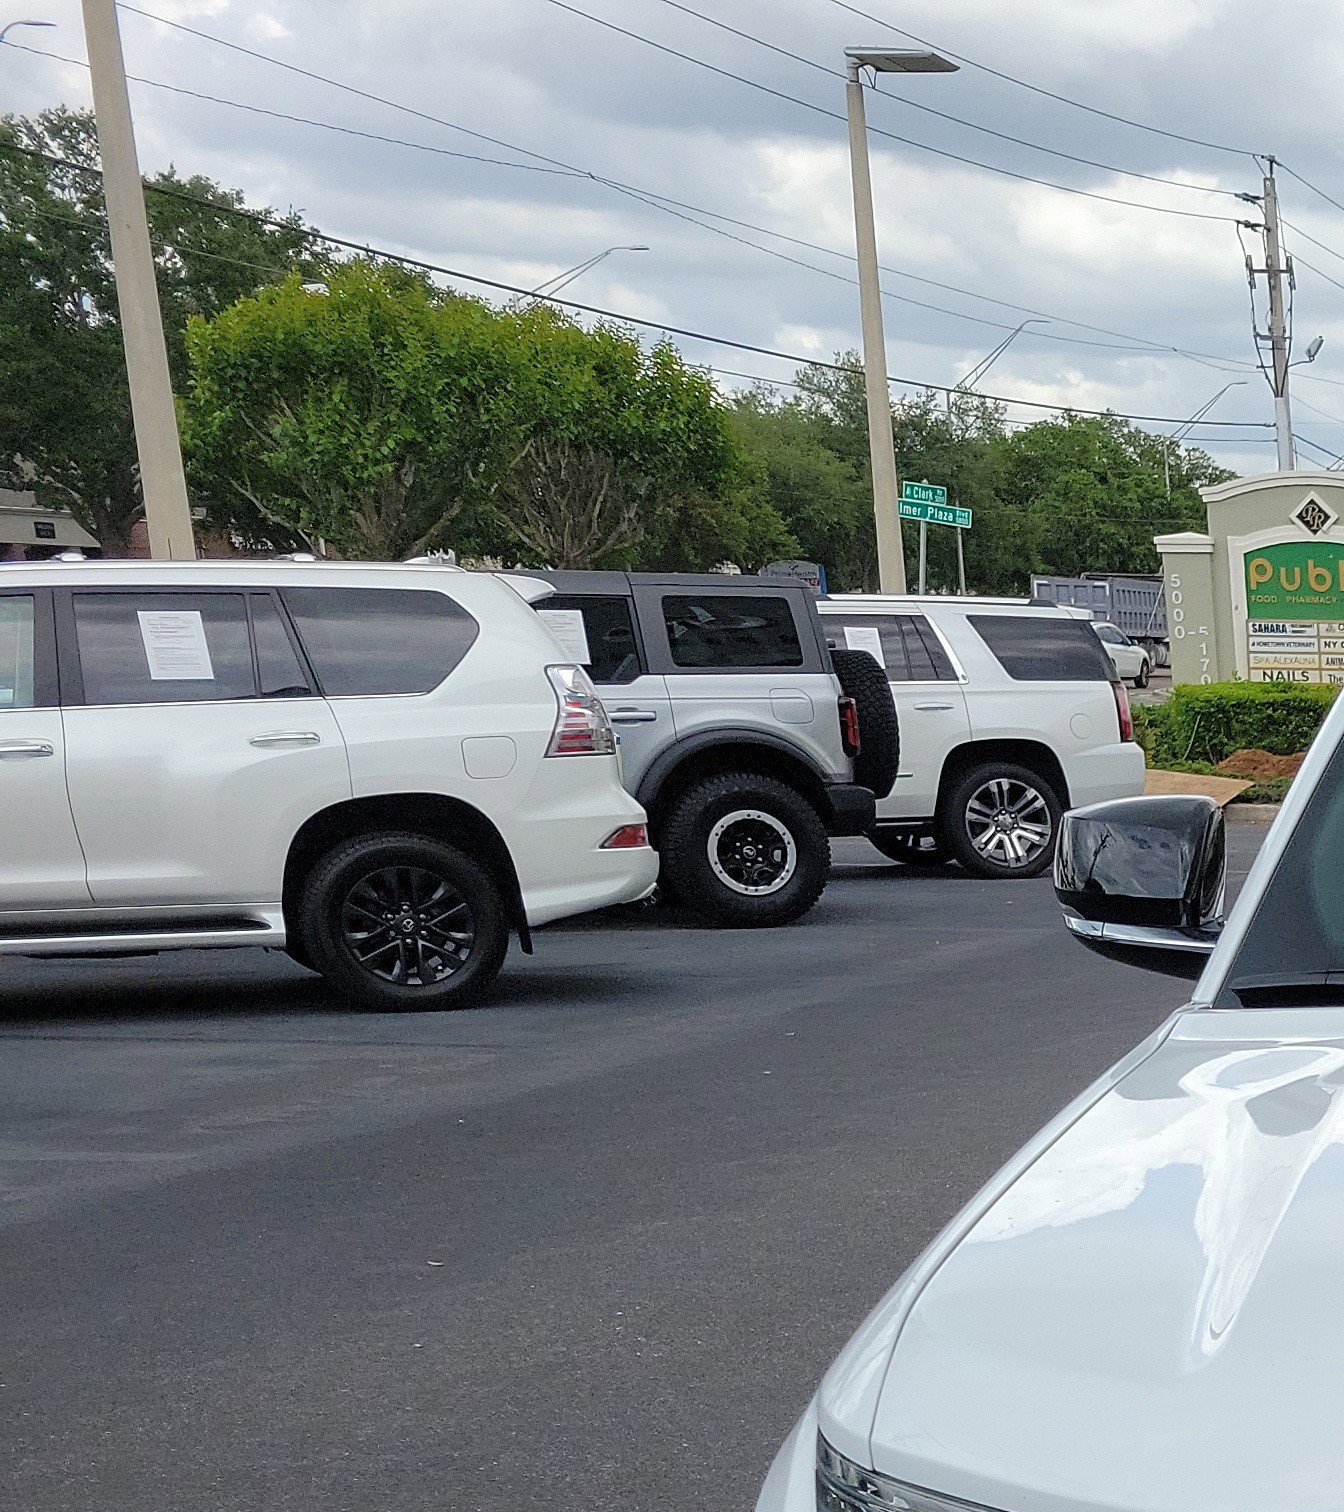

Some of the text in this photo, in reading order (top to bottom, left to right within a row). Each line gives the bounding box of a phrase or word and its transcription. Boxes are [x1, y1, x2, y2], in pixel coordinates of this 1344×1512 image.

[913, 486, 933, 500] Clark
[899, 502, 922, 516] lmer
[927, 506, 953, 521] Plaza
[1286, 595, 1337, 604] PHARMACY
[1252, 623, 1288, 634] SAHARA
[1324, 641, 1338, 649] NY
[1262, 670, 1310, 682] NAILS
[1327, 674, 1344, 684] The
